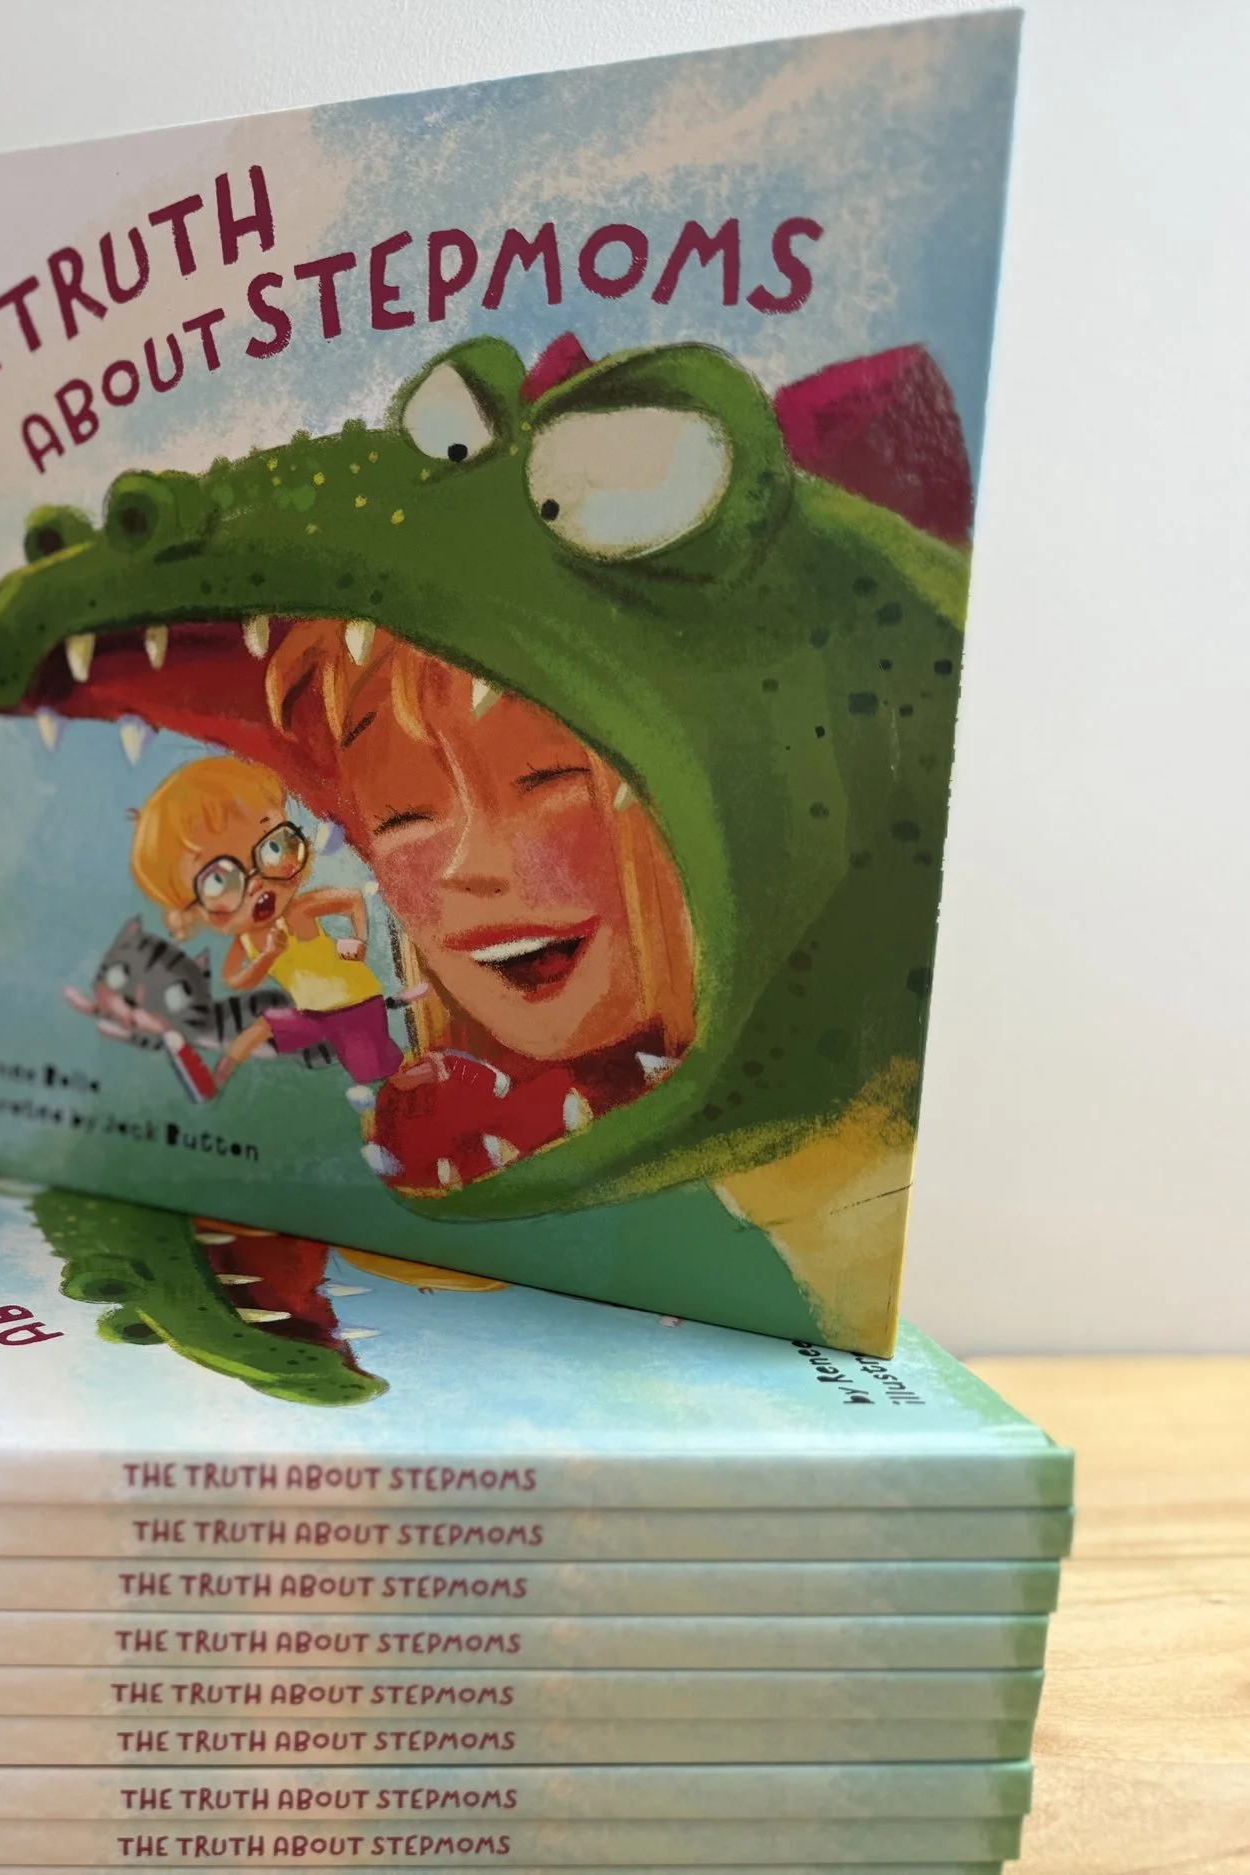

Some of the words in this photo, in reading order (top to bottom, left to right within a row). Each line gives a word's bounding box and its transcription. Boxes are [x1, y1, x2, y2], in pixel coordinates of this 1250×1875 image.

[20, 307, 226, 475] ABOUT
[244, 216, 825, 360] STEPMOMS
[104, 1112, 155, 1144] Jack
[164, 1122, 260, 1163] Button
[837, 1386, 875, 1404] by
[120, 1462, 179, 1488] THE
[185, 1462, 279, 1490] TRUTH
[285, 1463, 382, 1491] ABOUT
[388, 1466, 538, 1492] STEPMOMS
[132, 1518, 186, 1544] THE
[193, 1518, 287, 1545] TRUTH
[294, 1521, 391, 1547] ABOUT
[397, 1523, 544, 1547] STEPMOMS
[117, 1571, 172, 1597] THE
[178, 1571, 272, 1598] TRUTH
[279, 1573, 375, 1599] ABOUT
[381, 1575, 528, 1600] STEPMOMS
[113, 1627, 169, 1653] THE
[174, 1628, 268, 1655] TRUTH
[275, 1629, 371, 1655] ABOUT
[376, 1631, 522, 1655] STEPMOMS
[109, 1681, 164, 1705] THE
[169, 1681, 263, 1706] TRUTH
[270, 1682, 365, 1706] ABOUT
[369, 1683, 515, 1706] STEPMOMS
[116, 1729, 170, 1753] THE
[175, 1729, 267, 1754] TRUTH
[274, 1729, 368, 1753] ABOUT
[373, 1729, 516, 1753] STEPMOMS
[119, 1787, 173, 1811] THE
[178, 1786, 270, 1812] TRUTH
[277, 1787, 371, 1811] ABOUT
[375, 1787, 518, 1811] STEPMOMS
[116, 1834, 169, 1858] THE
[174, 1834, 265, 1859] TRUTH
[272, 1834, 366, 1858] ABOUT
[369, 1834, 511, 1857] STEPMOMS
